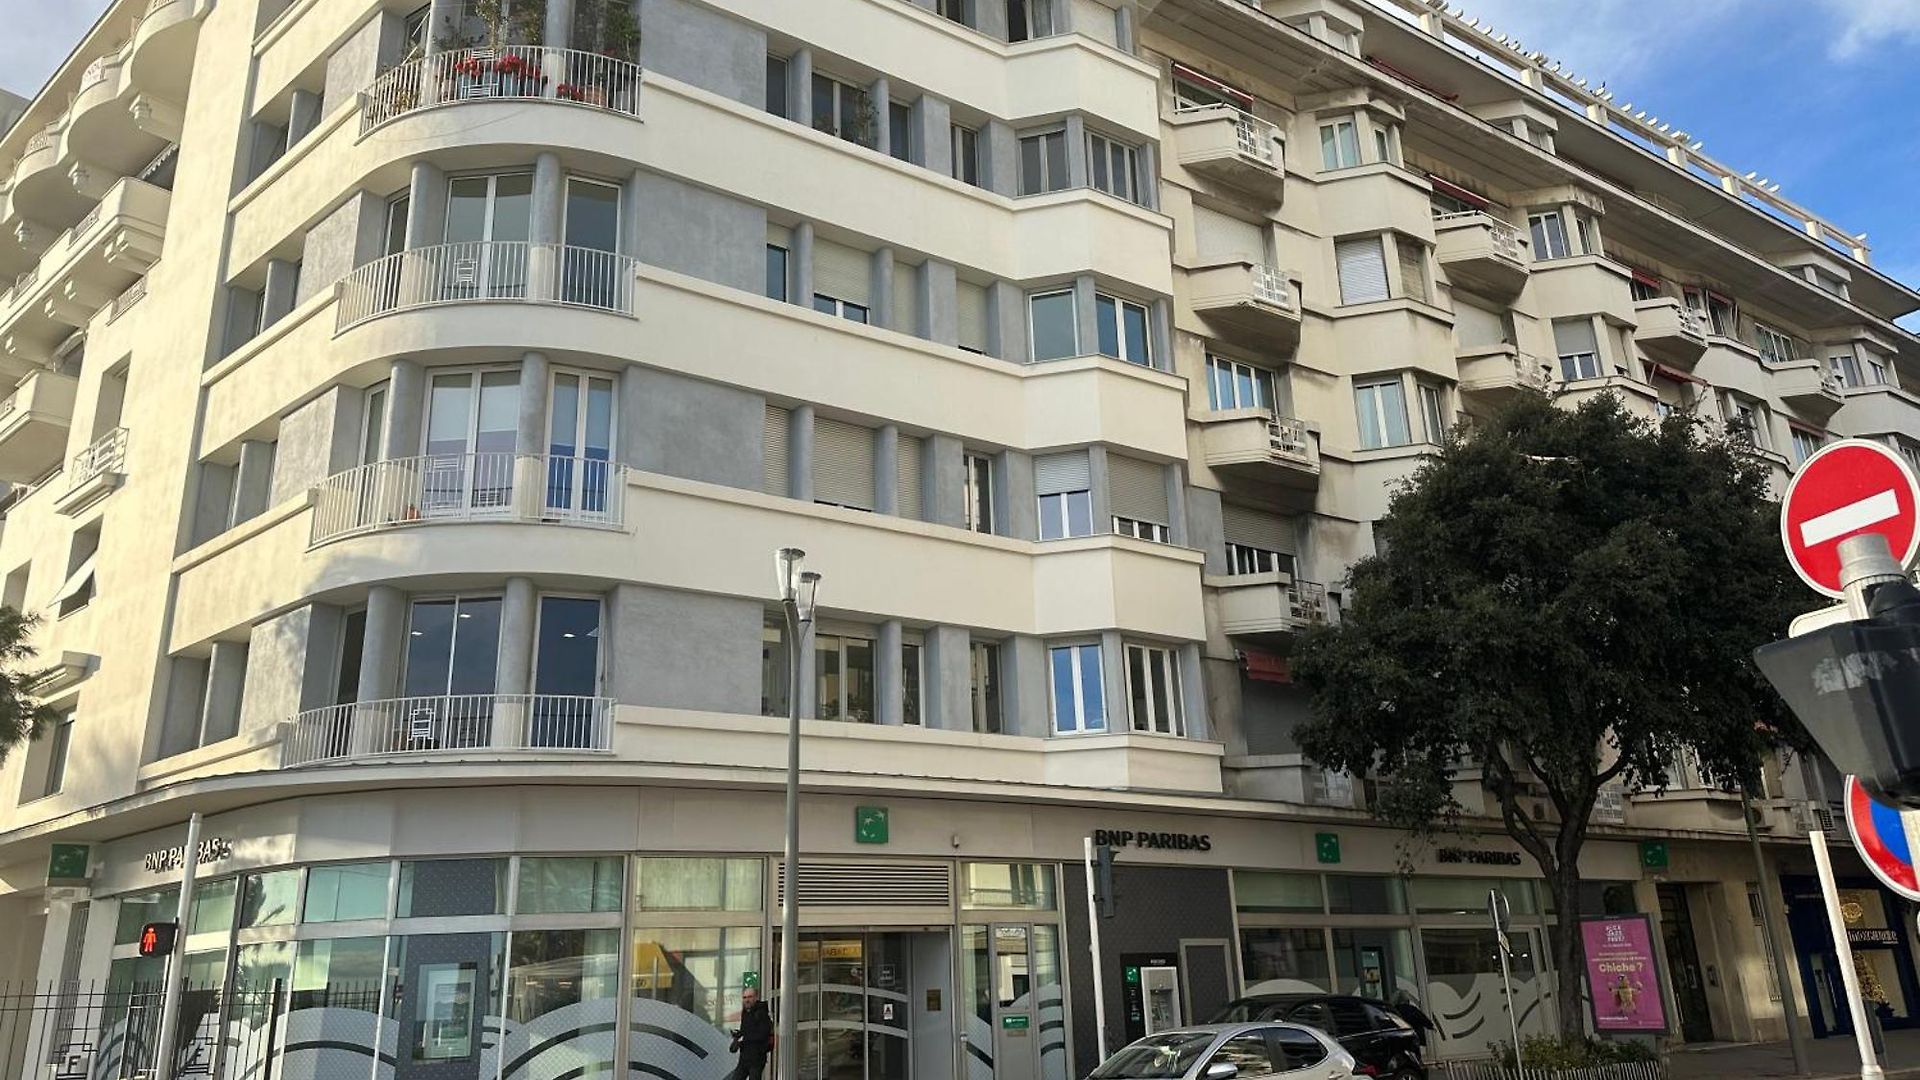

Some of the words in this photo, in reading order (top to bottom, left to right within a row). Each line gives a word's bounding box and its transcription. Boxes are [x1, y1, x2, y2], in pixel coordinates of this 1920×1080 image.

[1095, 829, 1133, 847] BNP
[1137, 831, 1211, 851] PARIBAS
[145, 849, 169, 872] BNP
[168, 838, 222, 869] PABAS
